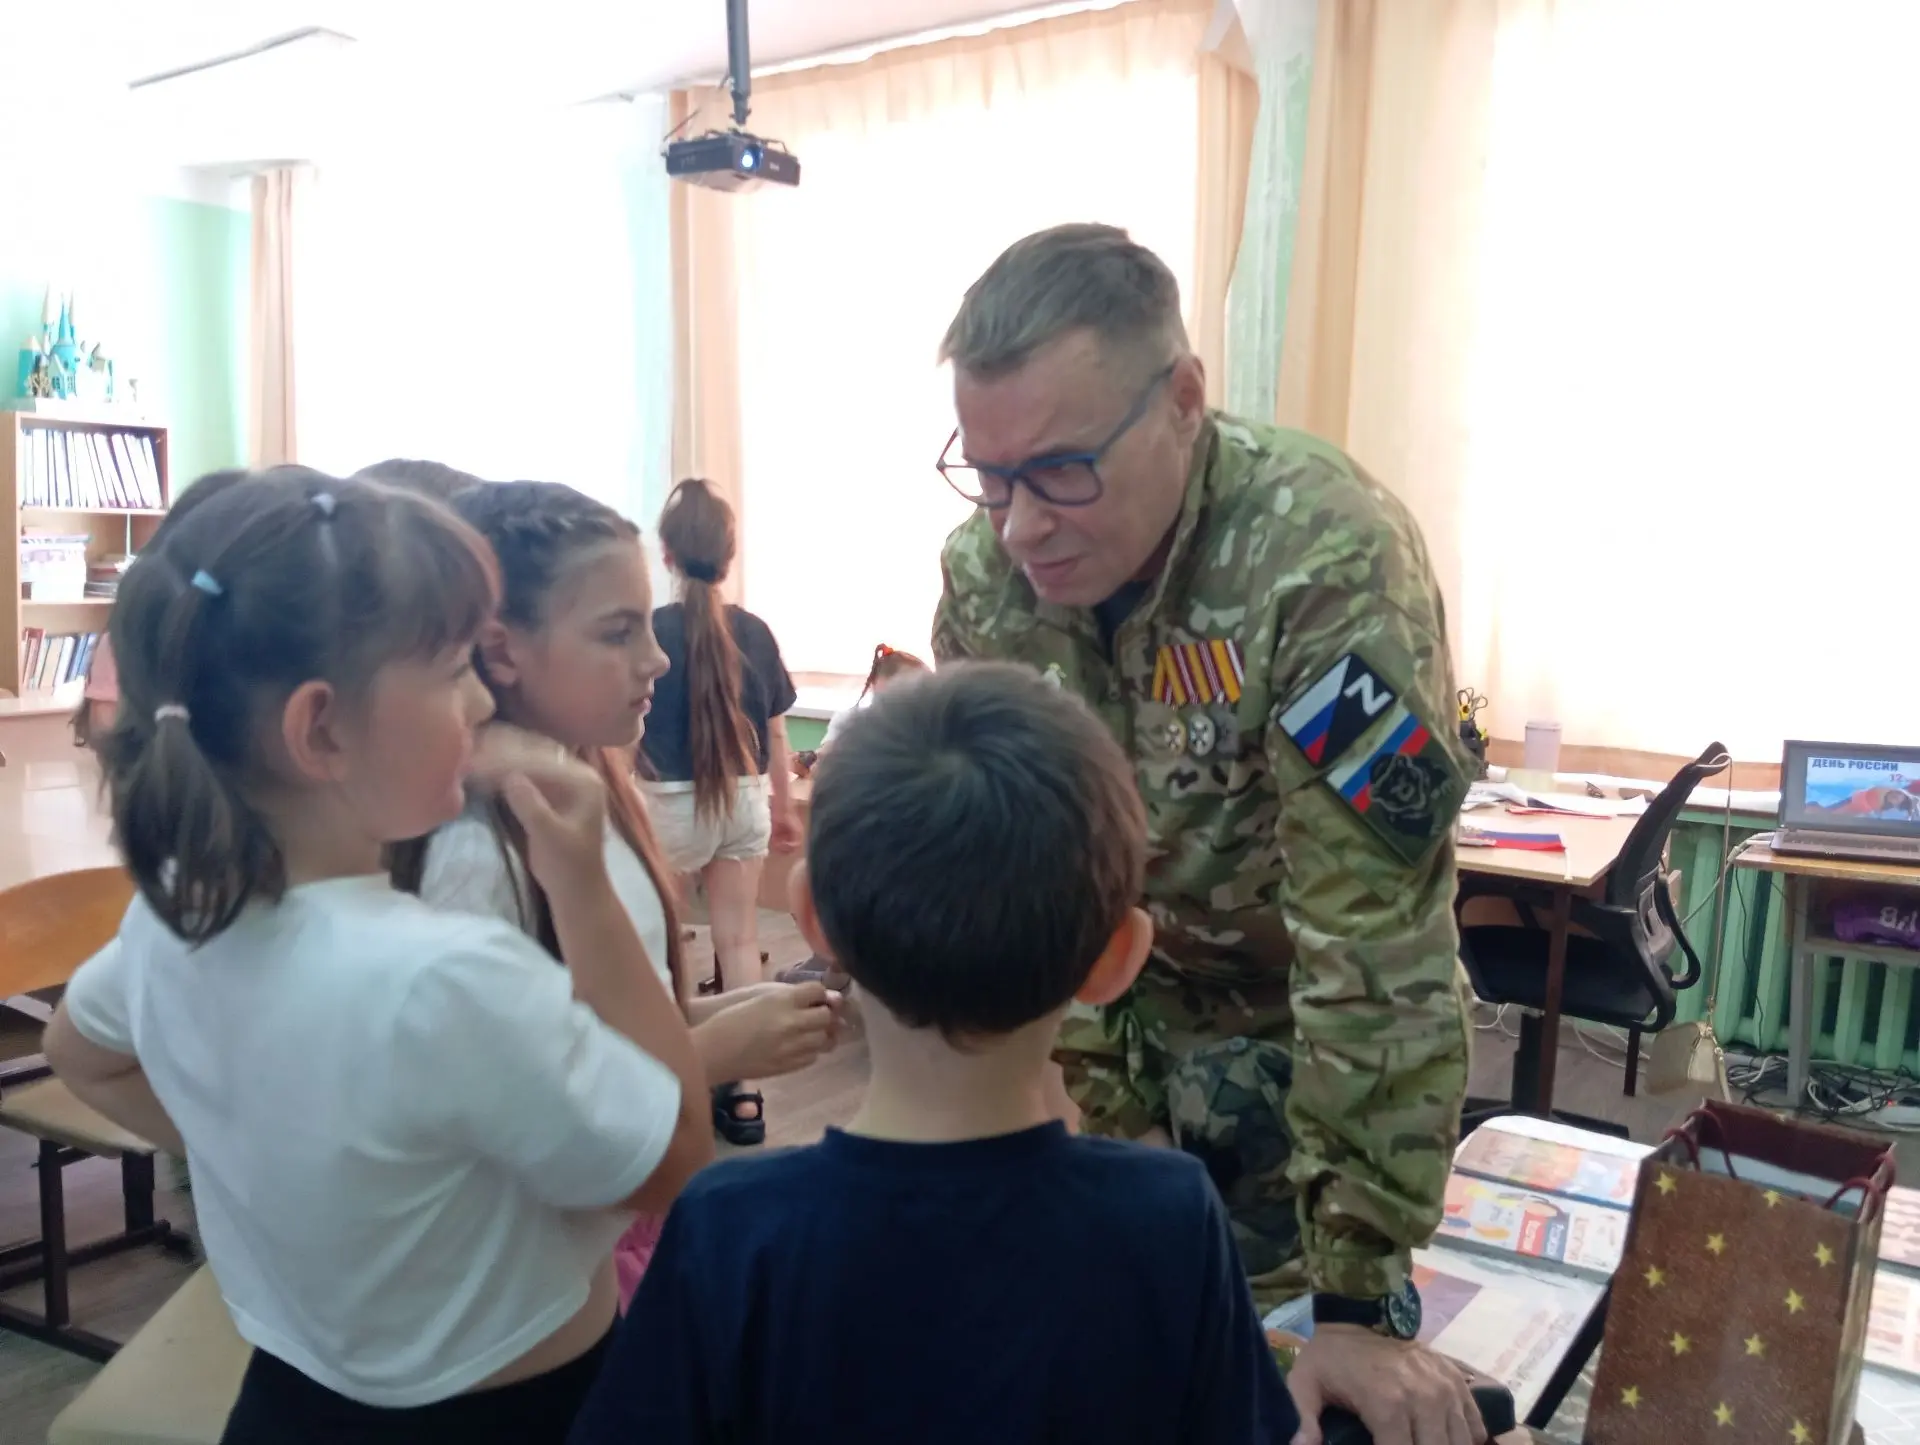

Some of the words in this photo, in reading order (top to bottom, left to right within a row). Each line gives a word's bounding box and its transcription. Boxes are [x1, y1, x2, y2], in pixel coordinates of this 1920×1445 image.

[1343, 673, 1393, 716] Z
[1812, 758, 1846, 769] ДЕНЬ
[1848, 760, 1899, 771] РОССИИ
